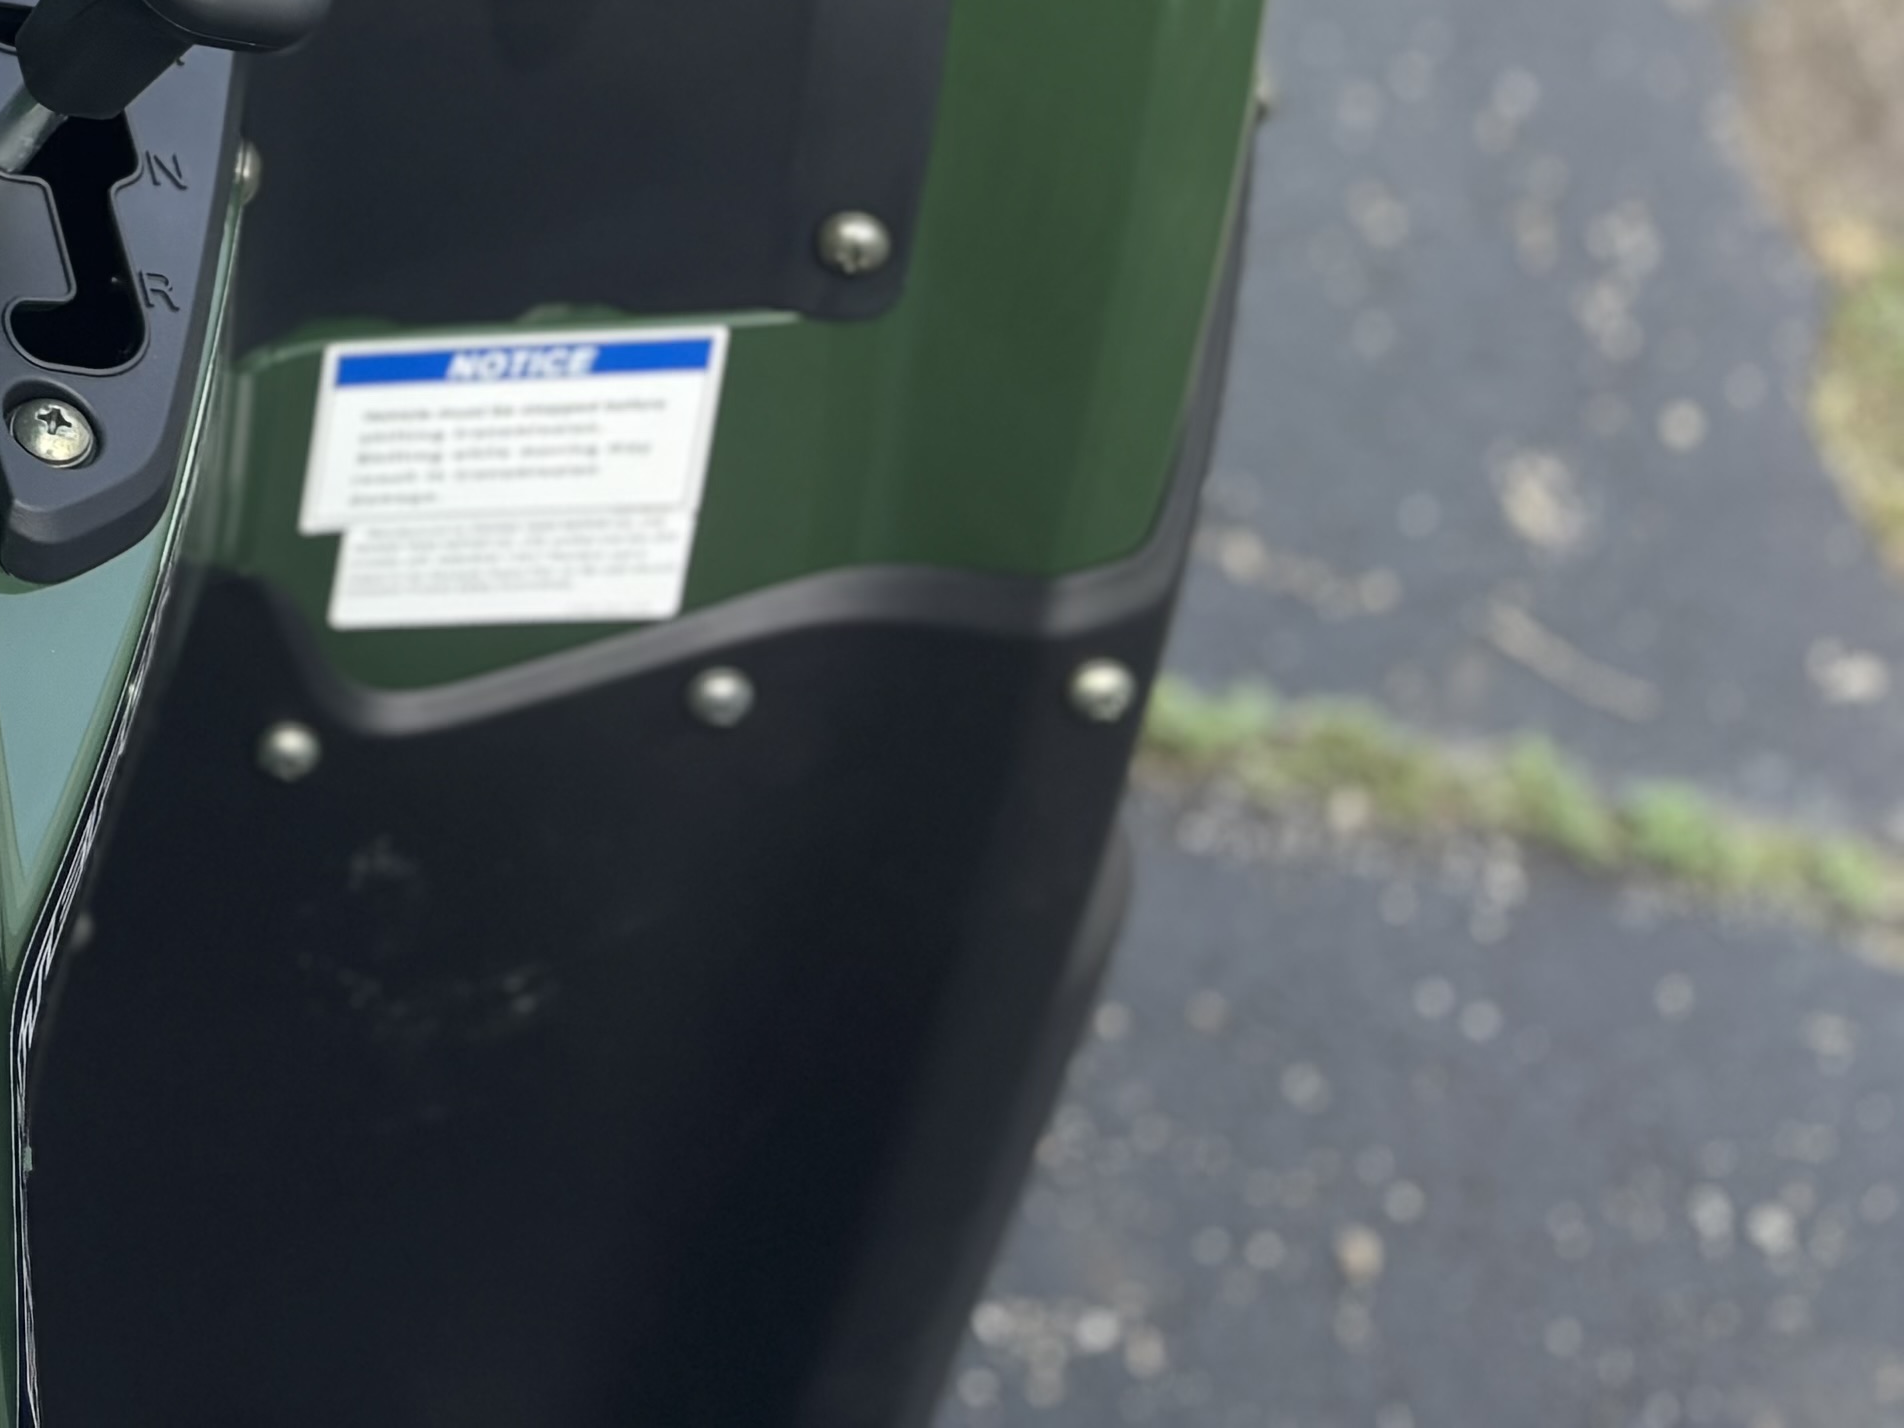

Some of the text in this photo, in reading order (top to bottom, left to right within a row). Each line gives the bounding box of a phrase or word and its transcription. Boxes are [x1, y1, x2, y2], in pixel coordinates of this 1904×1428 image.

[144, 150, 187, 190] N
[138, 270, 179, 312] R
[445, 346, 600, 382] NOTICE
